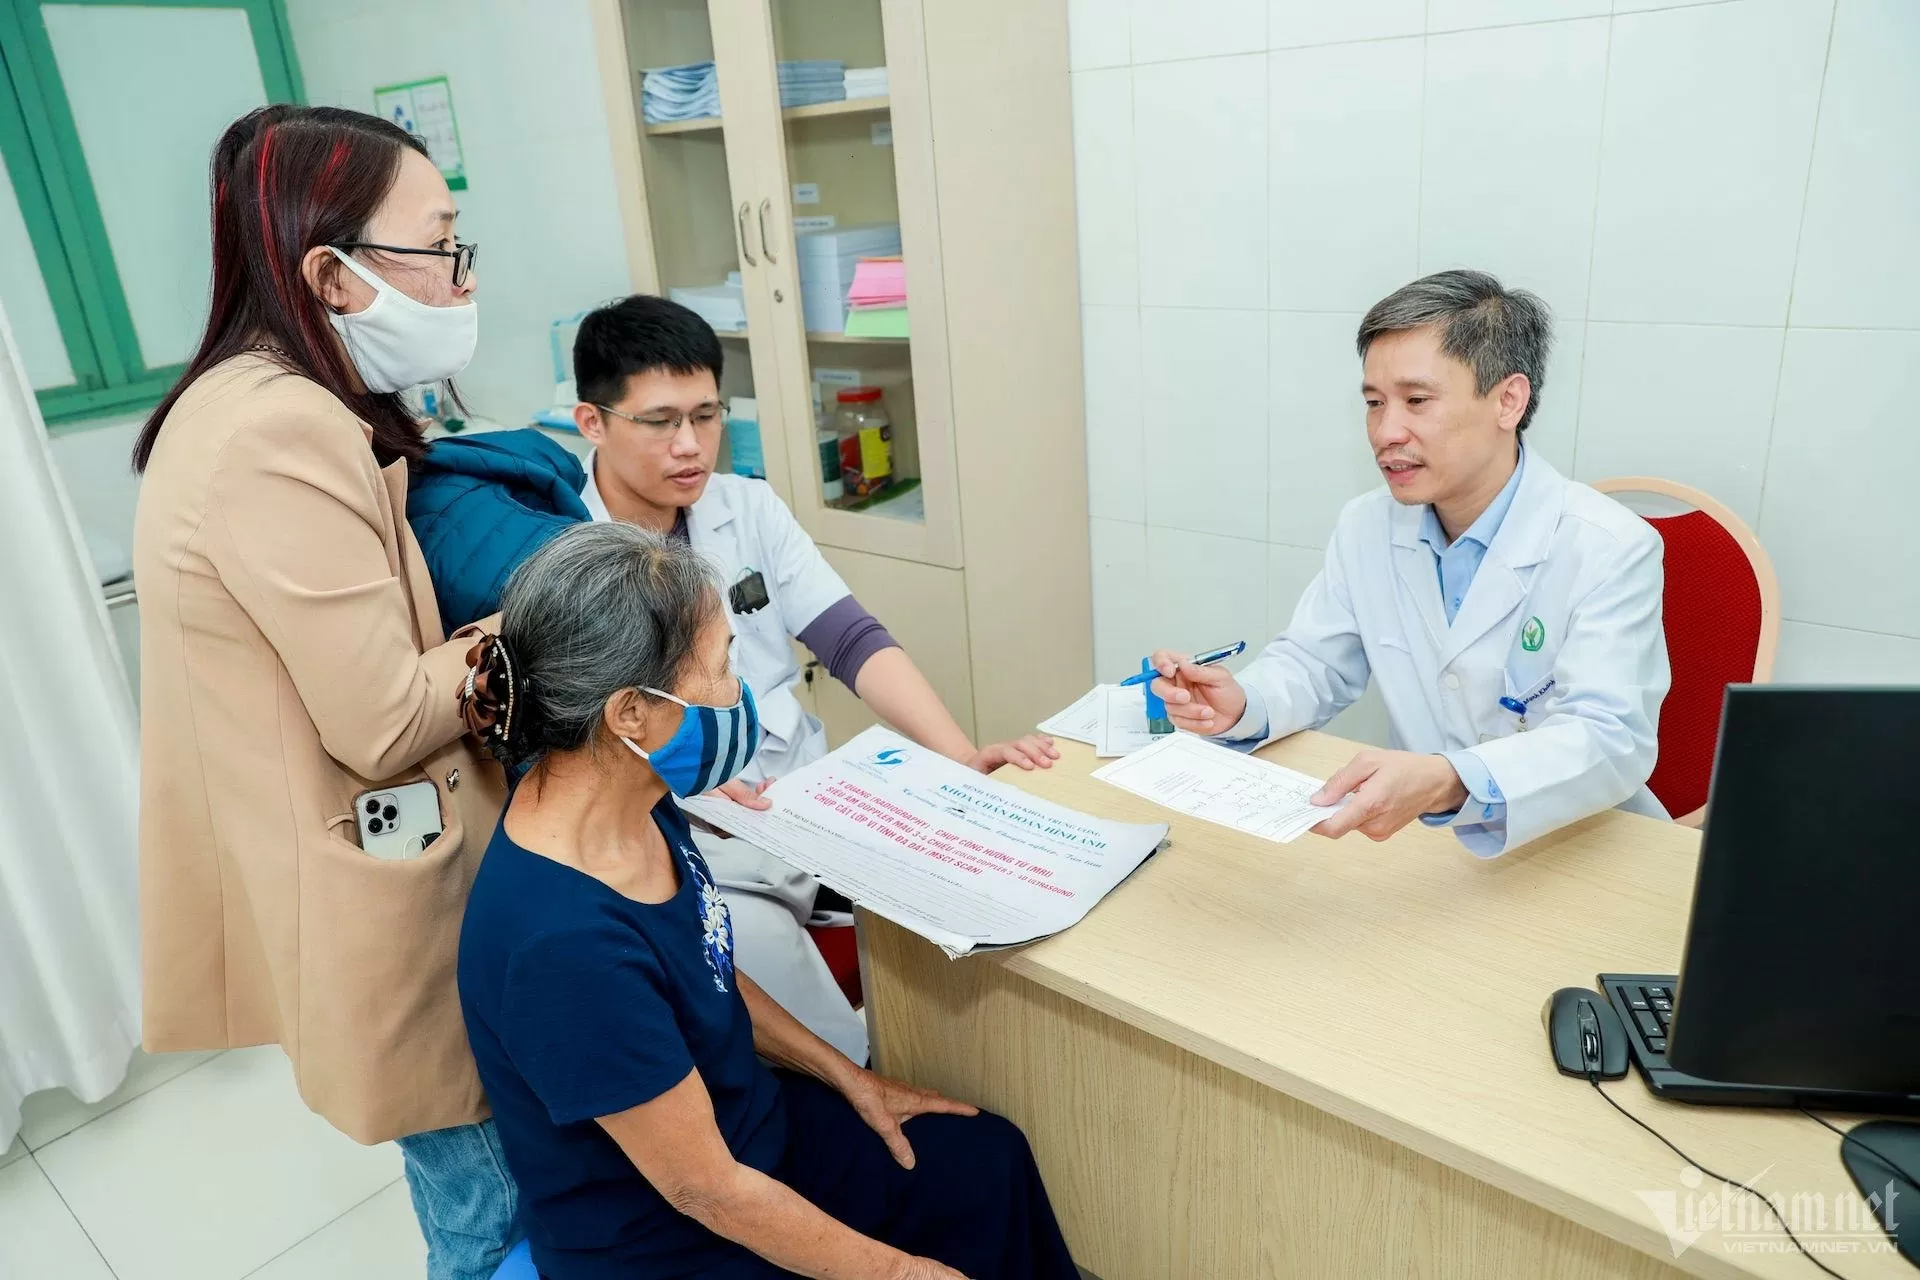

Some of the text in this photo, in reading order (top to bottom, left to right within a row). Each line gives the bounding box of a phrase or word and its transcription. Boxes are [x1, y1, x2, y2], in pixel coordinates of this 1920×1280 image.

[844, 784, 872, 798] QUANG
[870, 796, 931, 830] (RADIOGRAPHY)
[940, 784, 972, 802] KHOA
[857, 802, 895, 823] DOPPLER
[976, 858, 1008, 873] DOPPLER
[1028, 878, 1076, 898] ULTRASOUND)
[924, 850, 955, 862] (MSCT
[953, 860, 983, 875] SCAN)
